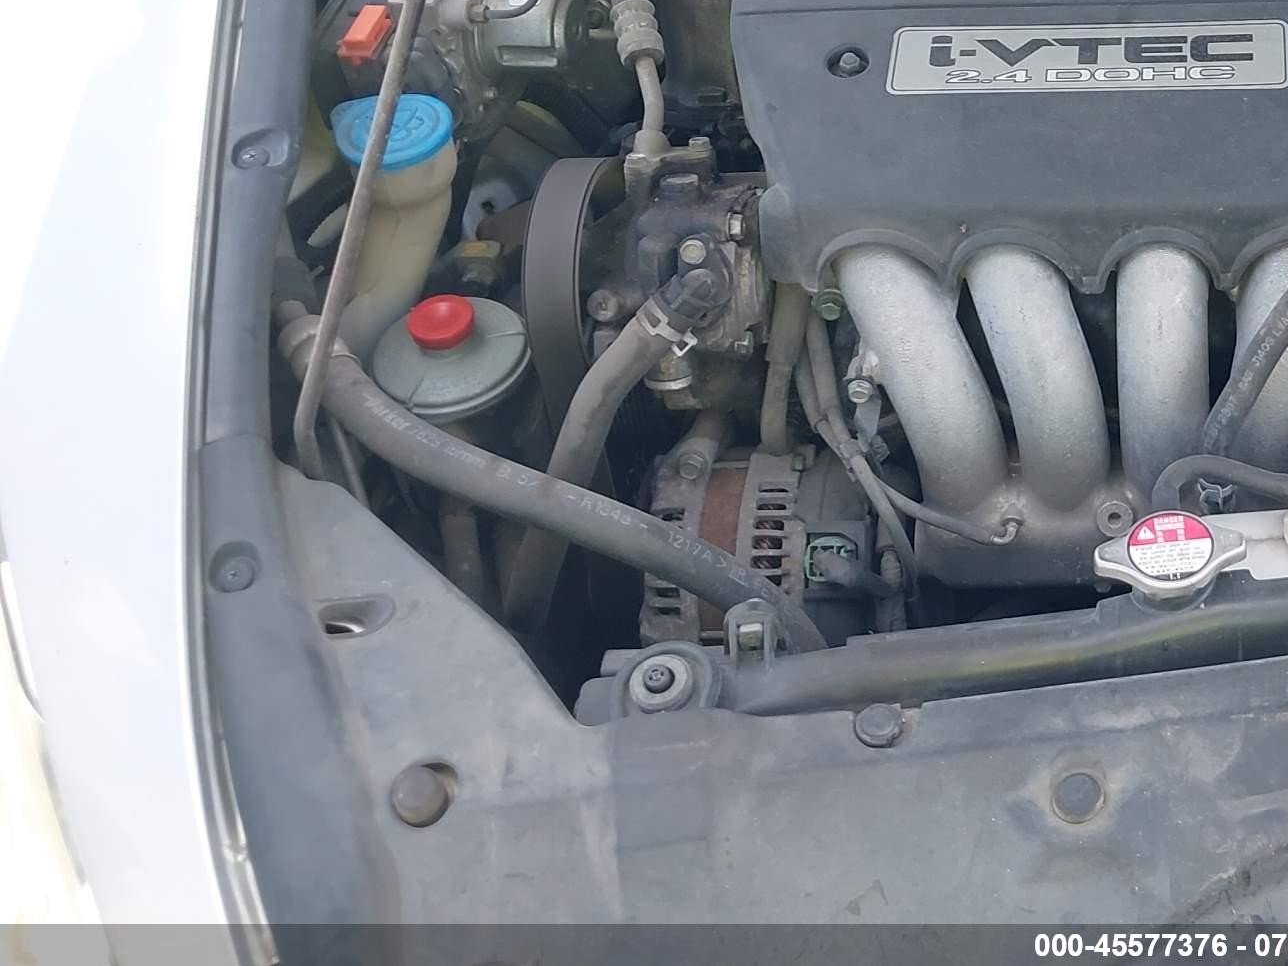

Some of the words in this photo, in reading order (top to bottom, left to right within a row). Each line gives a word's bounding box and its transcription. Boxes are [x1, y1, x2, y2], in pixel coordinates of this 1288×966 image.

[928, 34, 1254, 68] i-VTEC
[945, 69, 1032, 85] 2.4
[1045, 66, 1236, 84] DOHC
